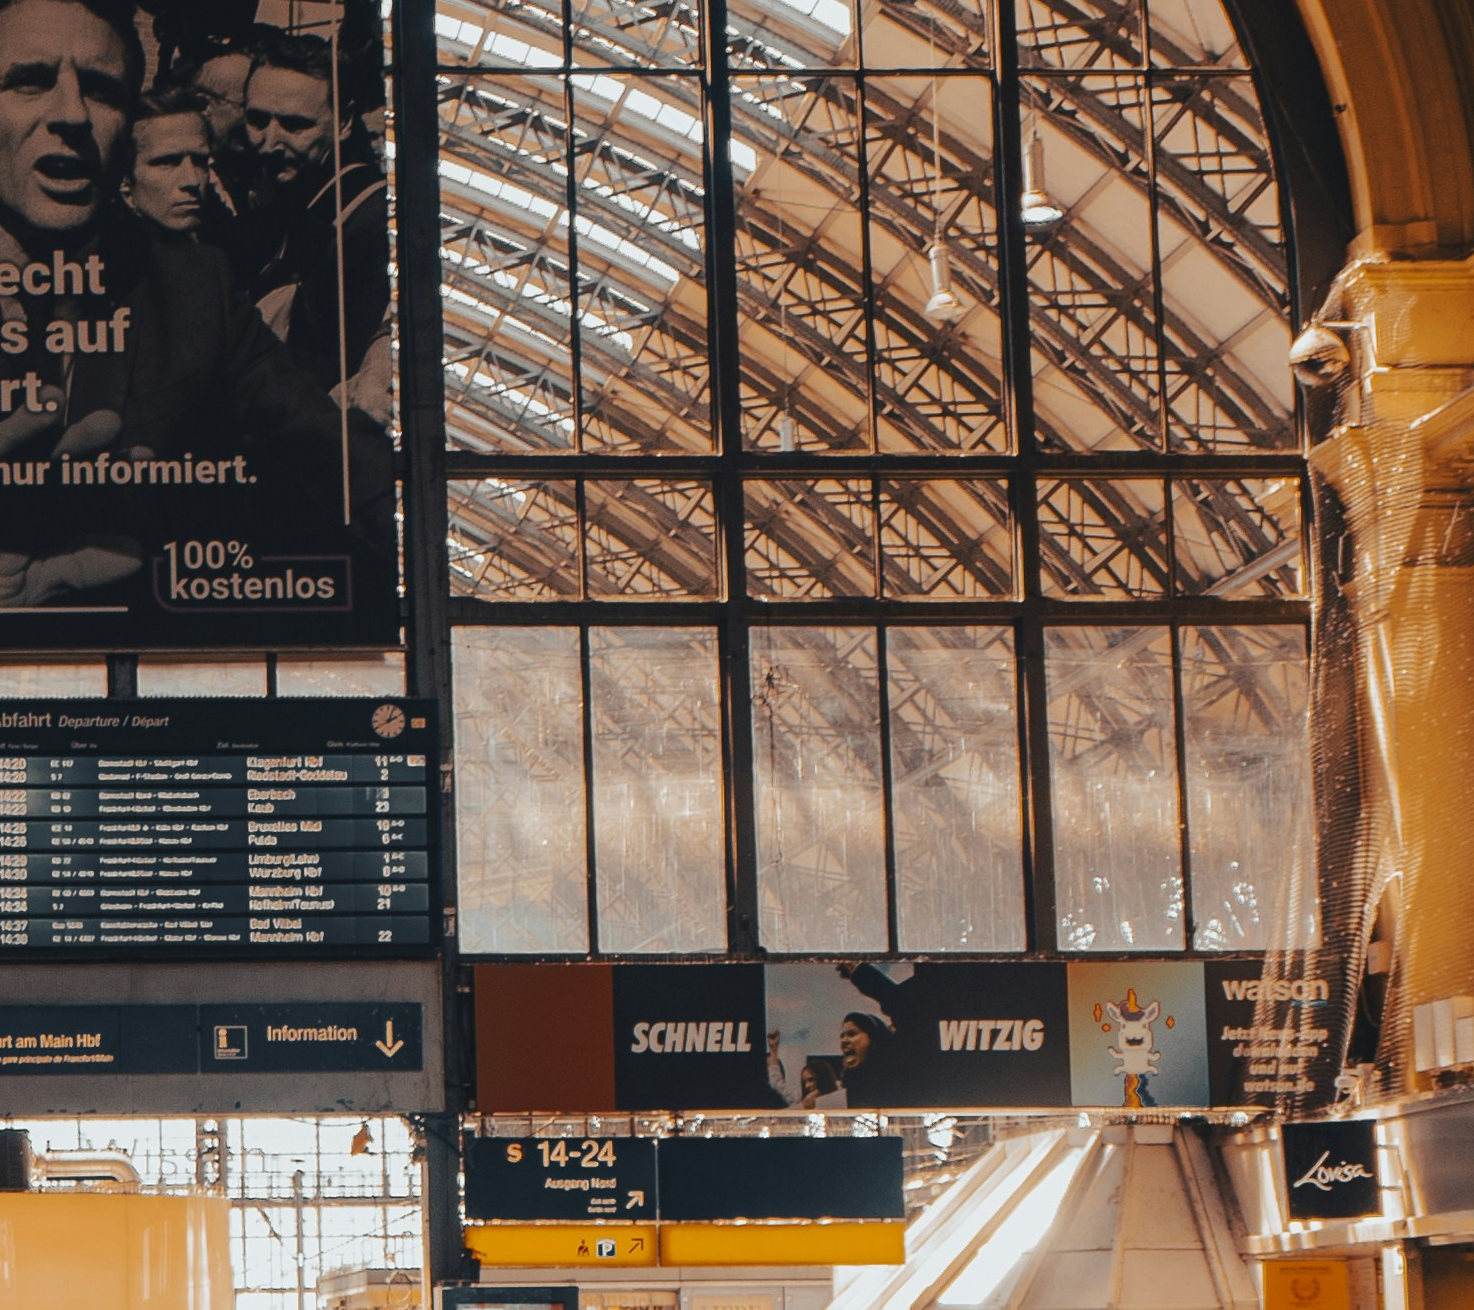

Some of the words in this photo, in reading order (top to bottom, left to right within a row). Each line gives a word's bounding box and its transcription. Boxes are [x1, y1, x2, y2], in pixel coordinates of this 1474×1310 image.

[45, 309, 130, 354] auf
[61, 455, 258, 486] informiert.
[162, 540, 254, 572] 100%
[170, 568, 336, 601] kostenlos
[58, 715, 120, 729] Departure
[132, 715, 169, 729] Départ
[305, 756, 323, 767] Hbf
[304, 867, 322, 877] Hbf
[249, 886, 302, 897] Mannheim
[305, 886, 323, 896] Hbf
[250, 932, 303, 943] Mannheim
[306, 932, 324, 942] Hbf
[378, 930, 392, 942] 22
[1222, 978, 1329, 1001] watson
[15, 1036, 37, 1049] am
[40, 1034, 73, 1048] Main
[77, 1033, 101, 1048] Hbf
[267, 1025, 357, 1042] Information
[631, 1021, 751, 1054] SCHNELL
[939, 1019, 1044, 1052] WITZIG
[537, 1139, 617, 1168] 14-24
[1294, 1150, 1373, 1189] Lovisa
[544, 1178, 589, 1191] Ausgang
[591, 1177, 617, 1189] Nord
